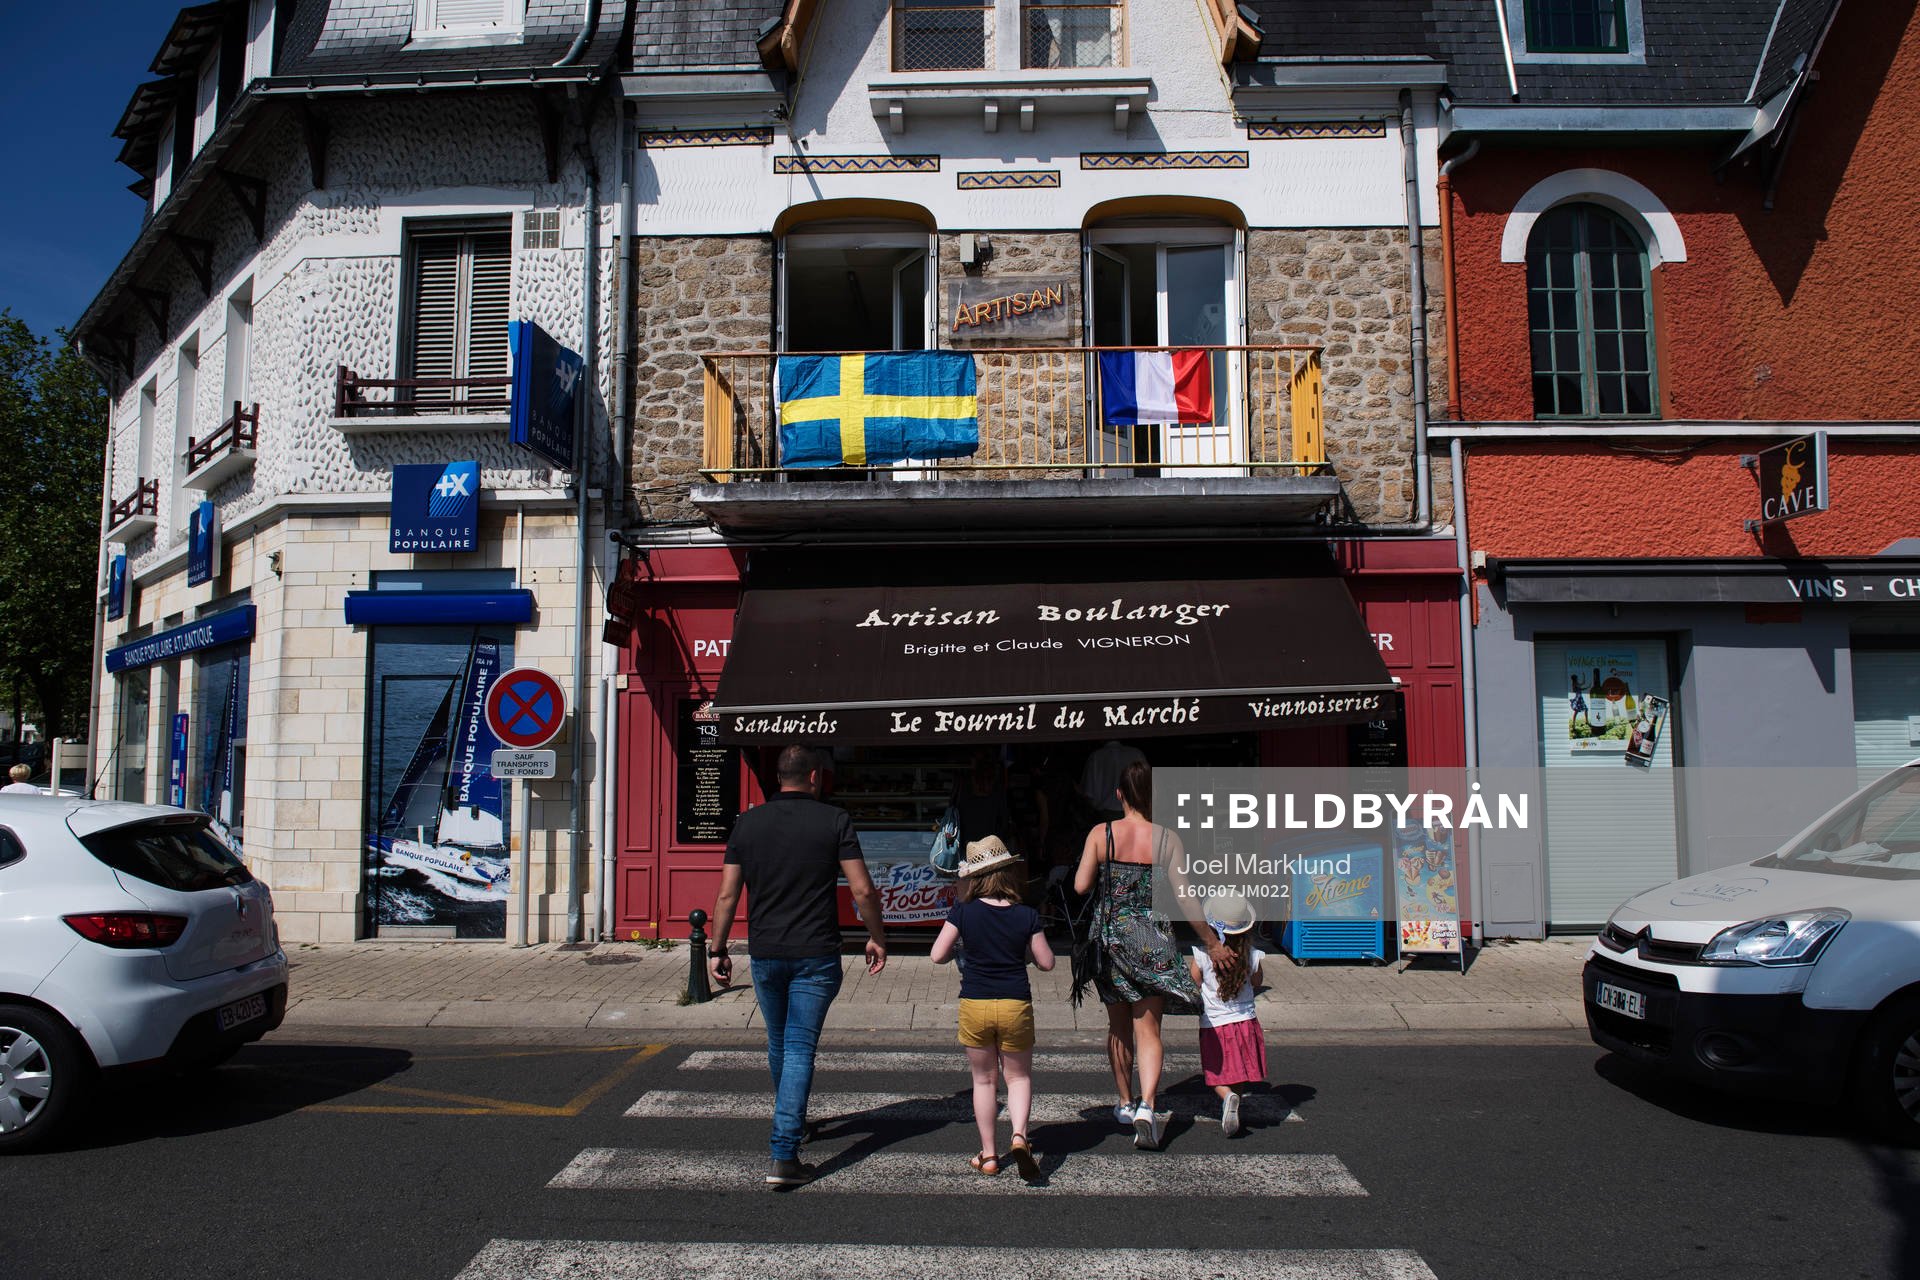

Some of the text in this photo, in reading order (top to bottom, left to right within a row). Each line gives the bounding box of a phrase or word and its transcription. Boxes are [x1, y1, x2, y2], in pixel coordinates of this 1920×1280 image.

[952, 283, 1063, 333] ARTISAN
[532, 409, 573, 442] BANQUE
[531, 429, 572, 461] POPULAIRE
[1763, 486, 1815, 520] CAVE
[394, 527, 470, 538] BANQUE
[394, 539, 470, 549] POPULAIRE
[1787, 578, 1847, 598] VINS
[855, 598, 1231, 628] Artisan Boulanger
[125, 625, 215, 667] BANQUE POPULAIRE ATLANTIQUE
[903, 634, 1191, 657] Brigitte et Claude VIGNERON
[890, 698, 1200, 733] Le Fournil du Marché
[1248, 692, 1380, 719] Viennoiseries
[459, 745, 476, 802] BANQUE
[468, 667, 488, 742] POPULAIRE
[734, 711, 838, 734] Sandwichs
[395, 847, 465, 873] BANQUE POPULAIRE
[909, 911, 921, 919] DU
[922, 909, 953, 919] MARCH
